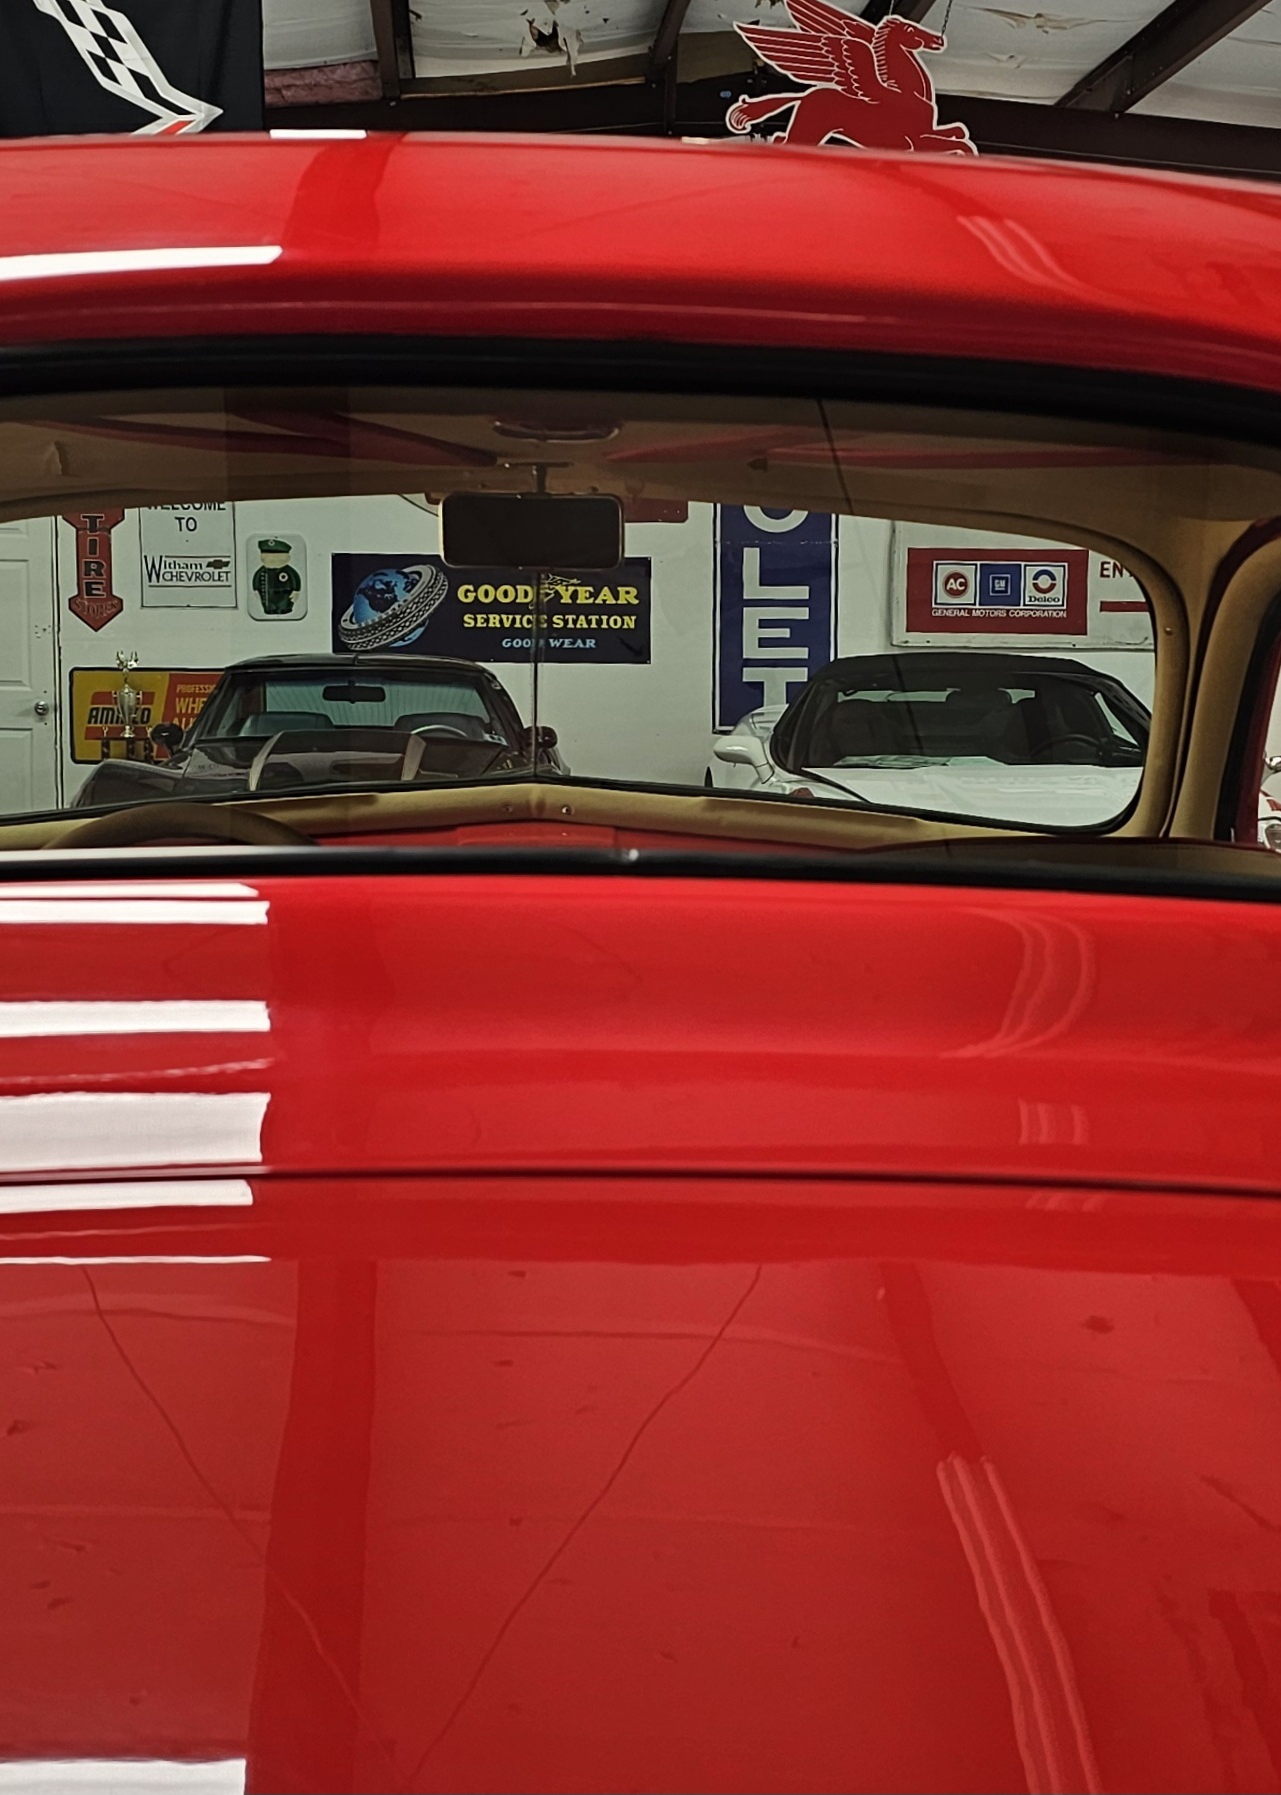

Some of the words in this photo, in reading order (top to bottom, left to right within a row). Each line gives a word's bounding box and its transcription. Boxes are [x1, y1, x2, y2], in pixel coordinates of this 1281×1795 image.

[173, 515, 199, 532] TO
[80, 513, 107, 599] TIRE
[143, 554, 204, 584] Witham
[161, 570, 233, 583] CHEVROLET
[946, 577, 966, 591] AC
[1027, 594, 1061, 604] Delco
[931, 608, 971, 618] GENERAL
[971, 608, 1007, 618] MOTORS
[1008, 609, 1067, 619] CORPORATION
[463, 613, 548, 629] SERVICE
[552, 614, 637, 630] STATION
[548, 638, 596, 649] WEAR
